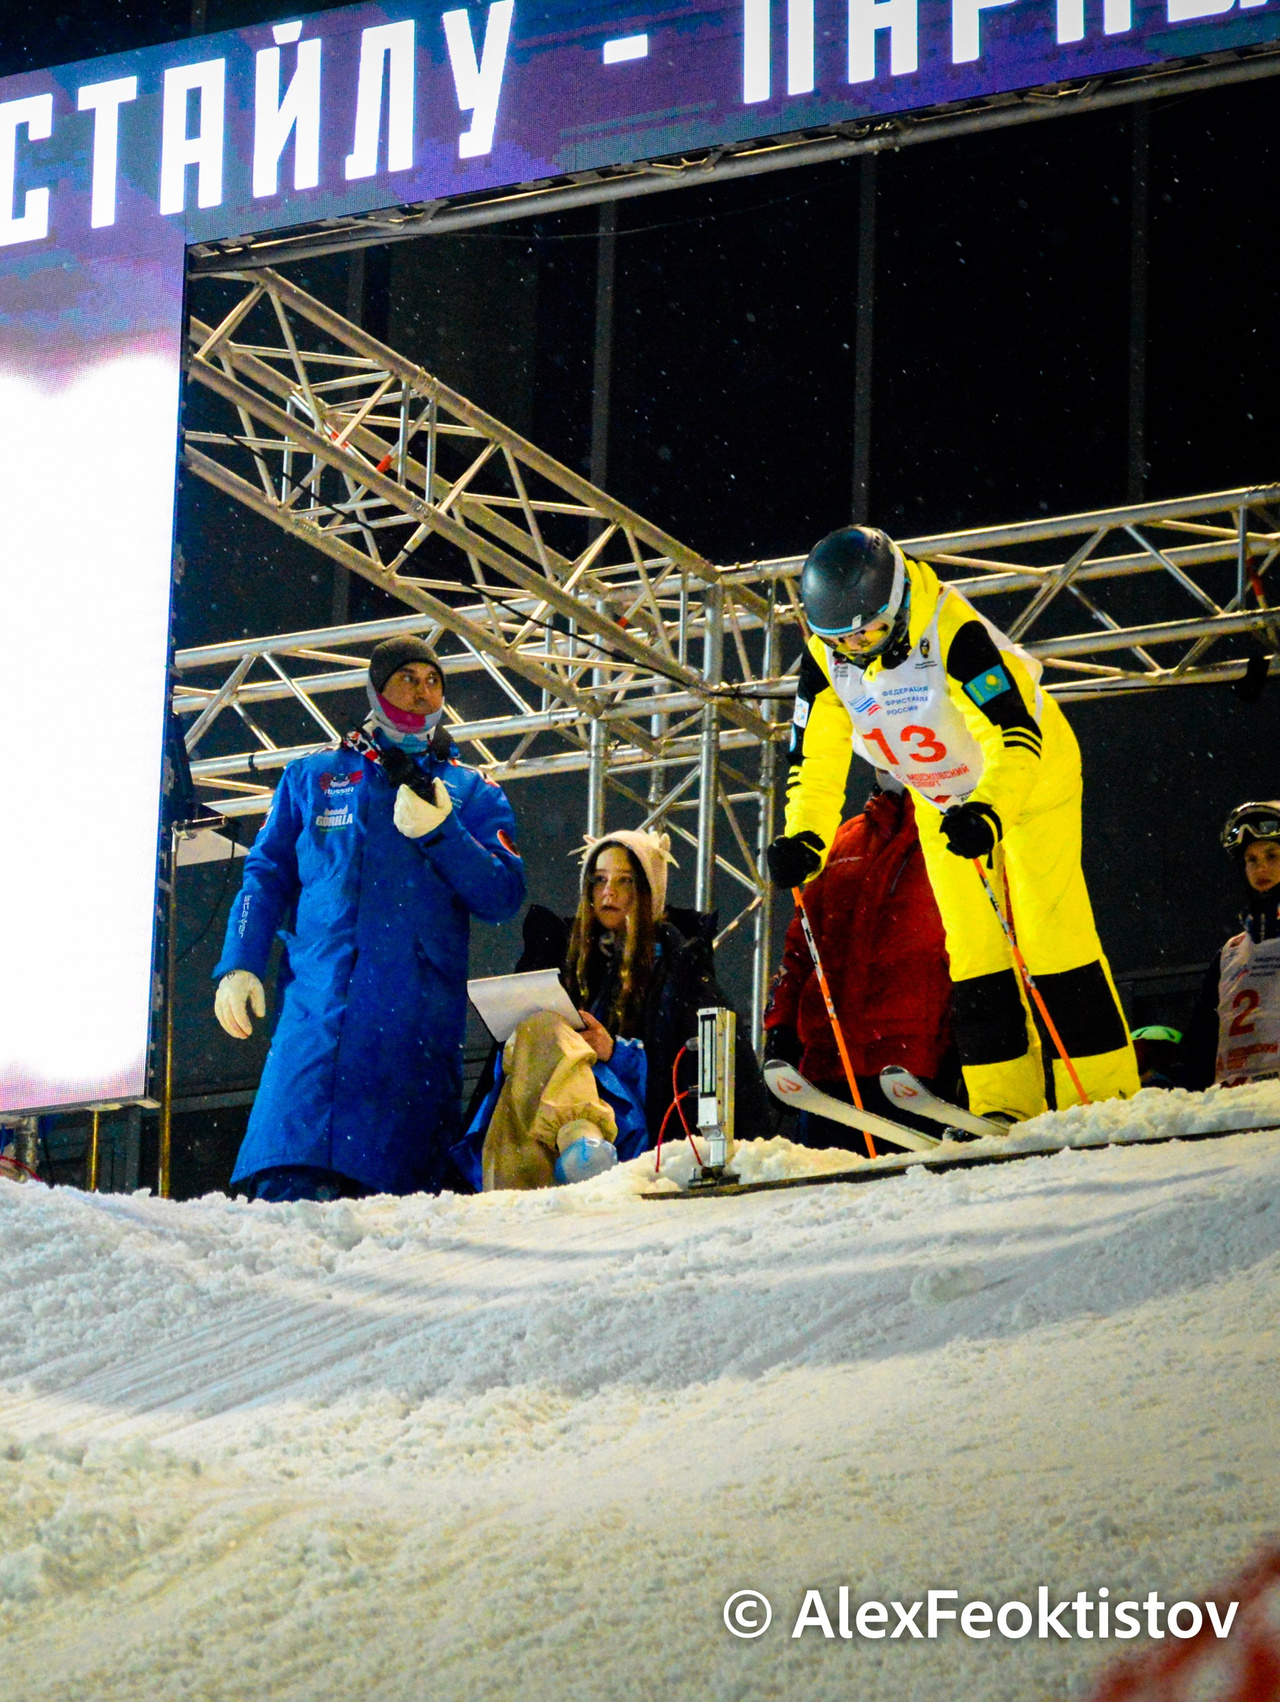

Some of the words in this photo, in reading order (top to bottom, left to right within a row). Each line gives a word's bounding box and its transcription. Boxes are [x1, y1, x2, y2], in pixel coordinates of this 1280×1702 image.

[882, 685, 929, 697] ФЕДЕРАЦИЯ
[886, 706, 919, 716] РОССИИ
[862, 724, 948, 766] 13
[906, 763, 970, 782] МОСКОВСКИЙ
[315, 813, 354, 827] GORILLA
[1229, 989, 1260, 1037] 2
